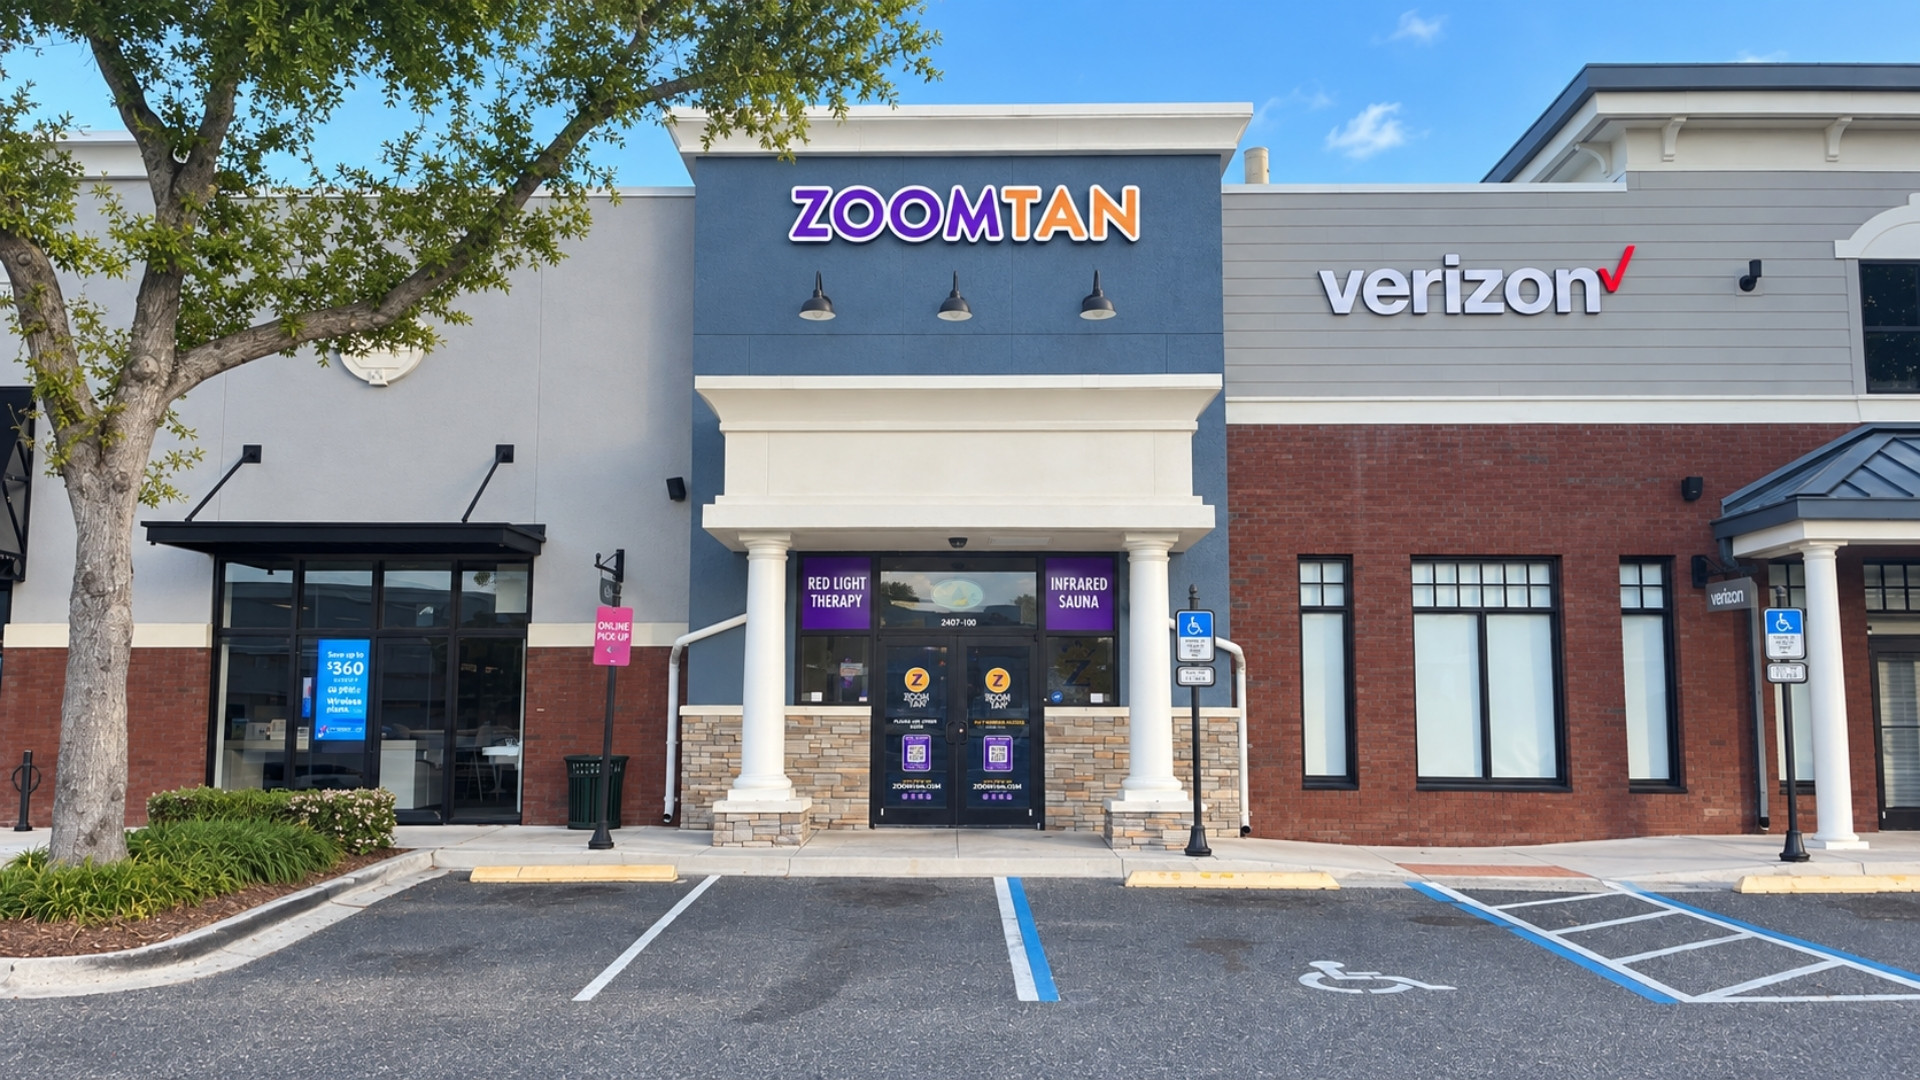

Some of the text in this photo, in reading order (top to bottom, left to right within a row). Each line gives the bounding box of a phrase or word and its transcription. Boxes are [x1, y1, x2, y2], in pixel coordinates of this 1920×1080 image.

[789, 185, 1140, 242] ZOOMTAN
[1317, 253, 1598, 315] verizon
[808, 576, 867, 590] RED LIGHT
[1051, 577, 1108, 590] INFRARED
[810, 594, 862, 608] THERAPY
[1059, 595, 1099, 608] SAUNA
[1710, 588, 1744, 605] verizon
[941, 618, 977, 627] 2407-100
[327, 661, 364, 676] $360
[911, 674, 923, 686] Z
[992, 674, 1004, 687] Z
